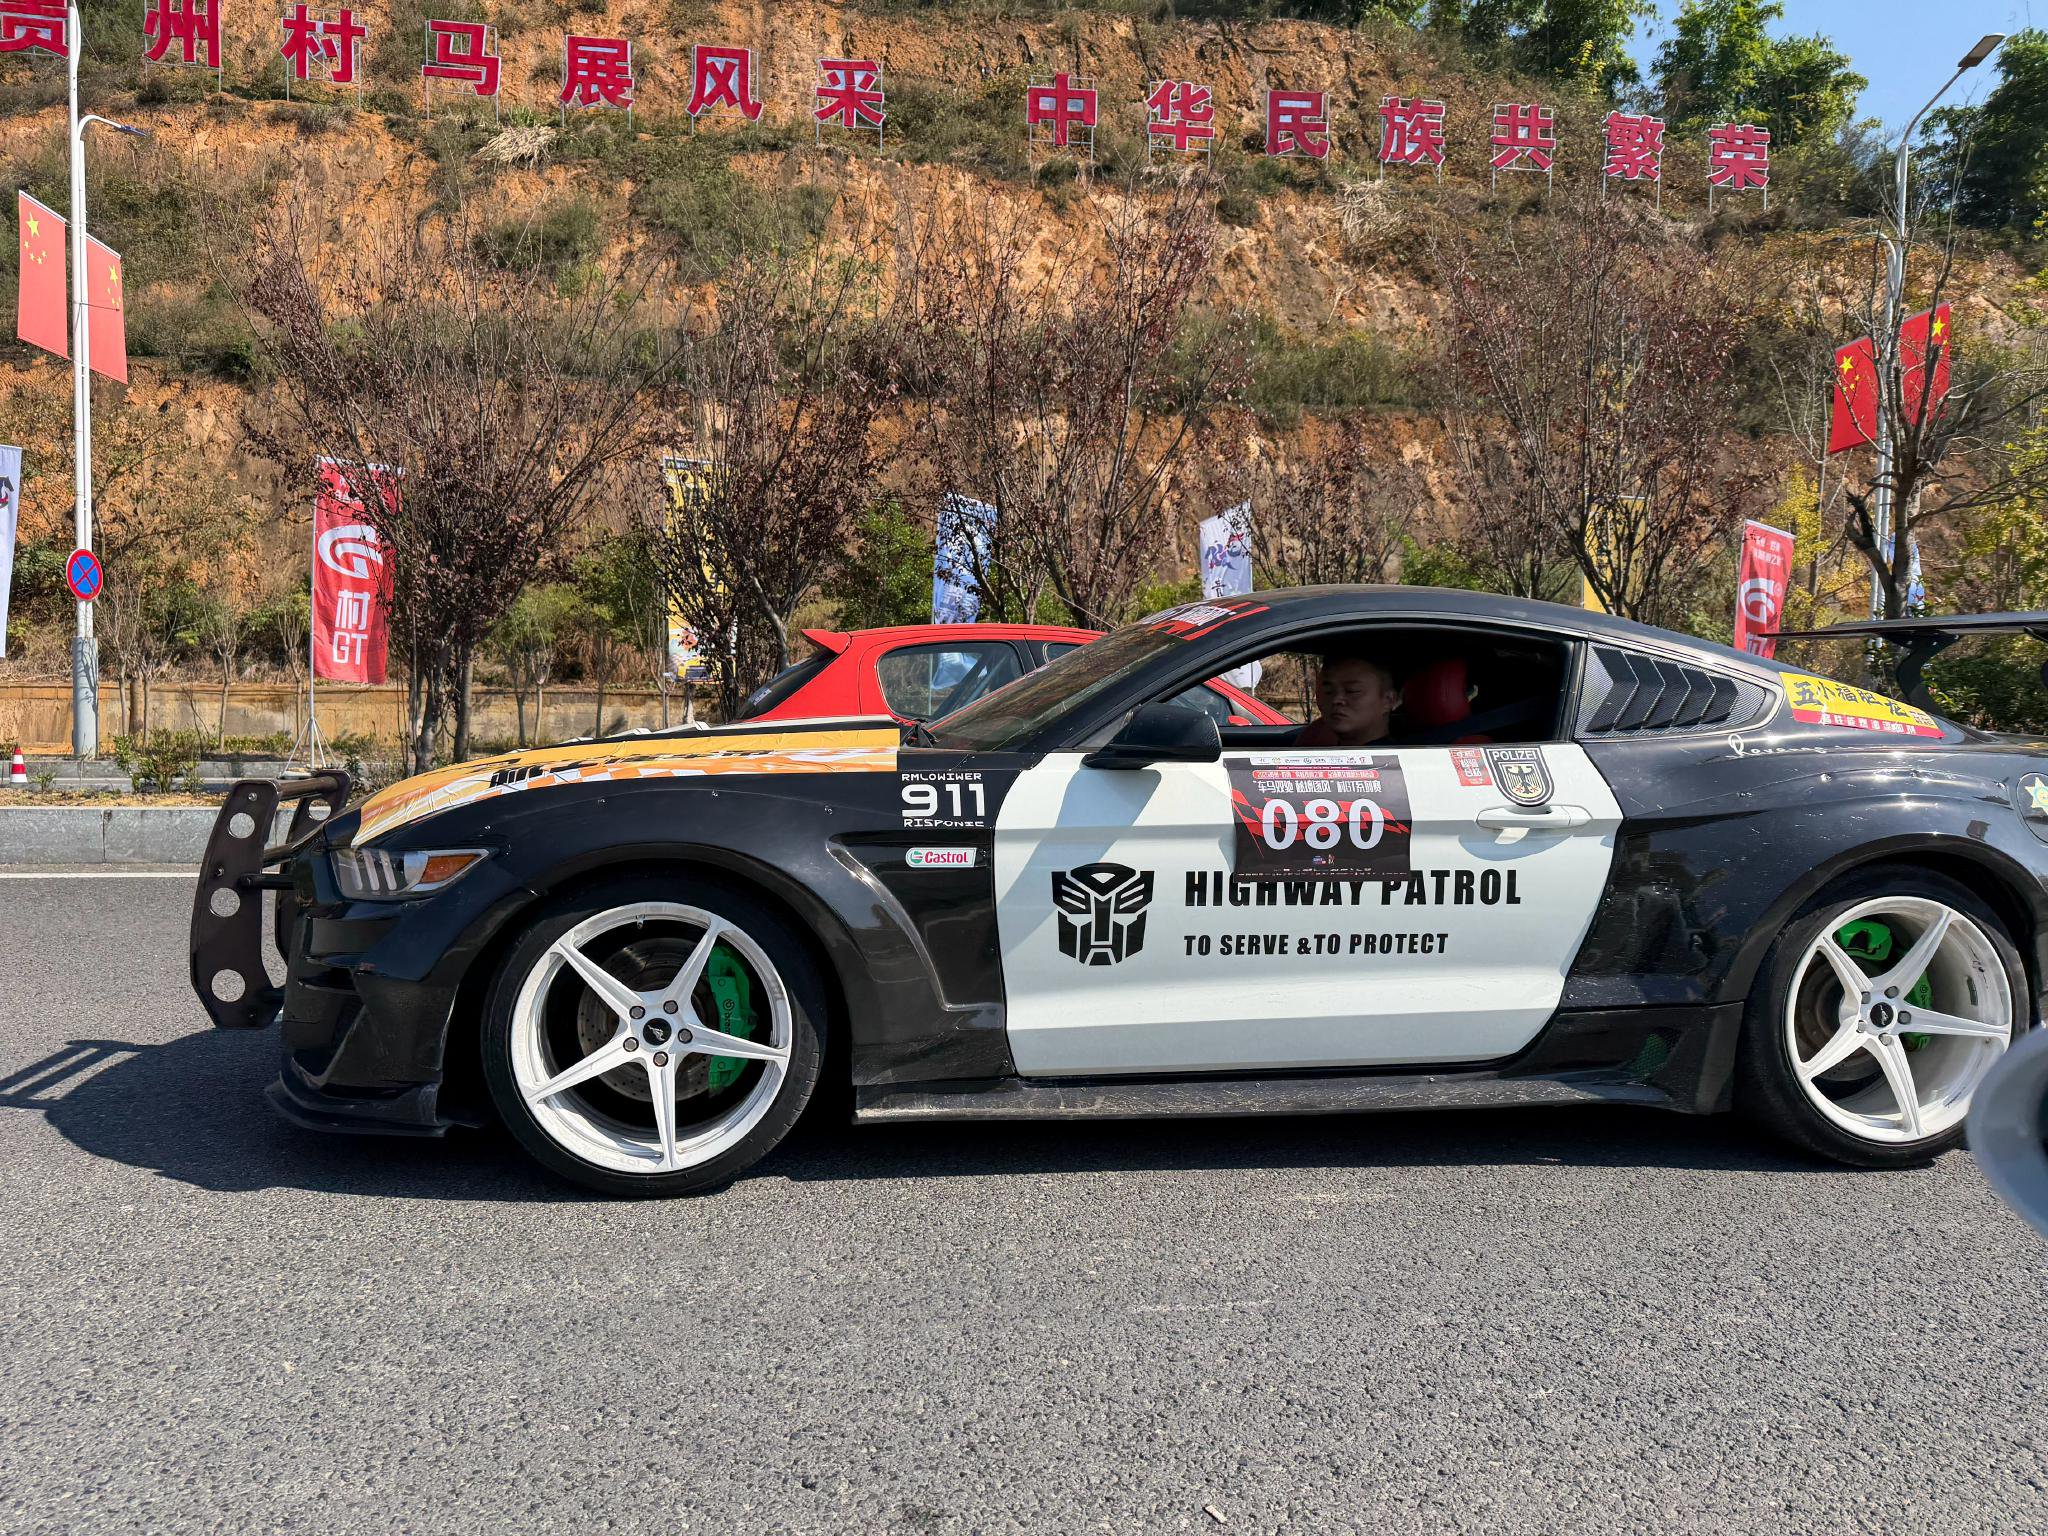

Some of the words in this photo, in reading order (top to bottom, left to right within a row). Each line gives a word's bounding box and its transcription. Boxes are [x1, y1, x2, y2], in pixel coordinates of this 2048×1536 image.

[1027, 71, 1770, 190] 中华民族共繁荣
[335, 588, 370, 630] 村
[332, 630, 368, 665] GT
[1492, 751, 1538, 761] POLIZEI
[901, 783, 985, 817] 911
[1262, 798, 1385, 850] 080
[925, 851, 968, 864] Castrol
[1185, 870, 1366, 906] HIGHWAY
[1381, 869, 1521, 905] PATROL
[1184, 935, 1211, 955] TO
[1220, 934, 1289, 955] SERVE
[1349, 933, 1449, 954] PROTECT
